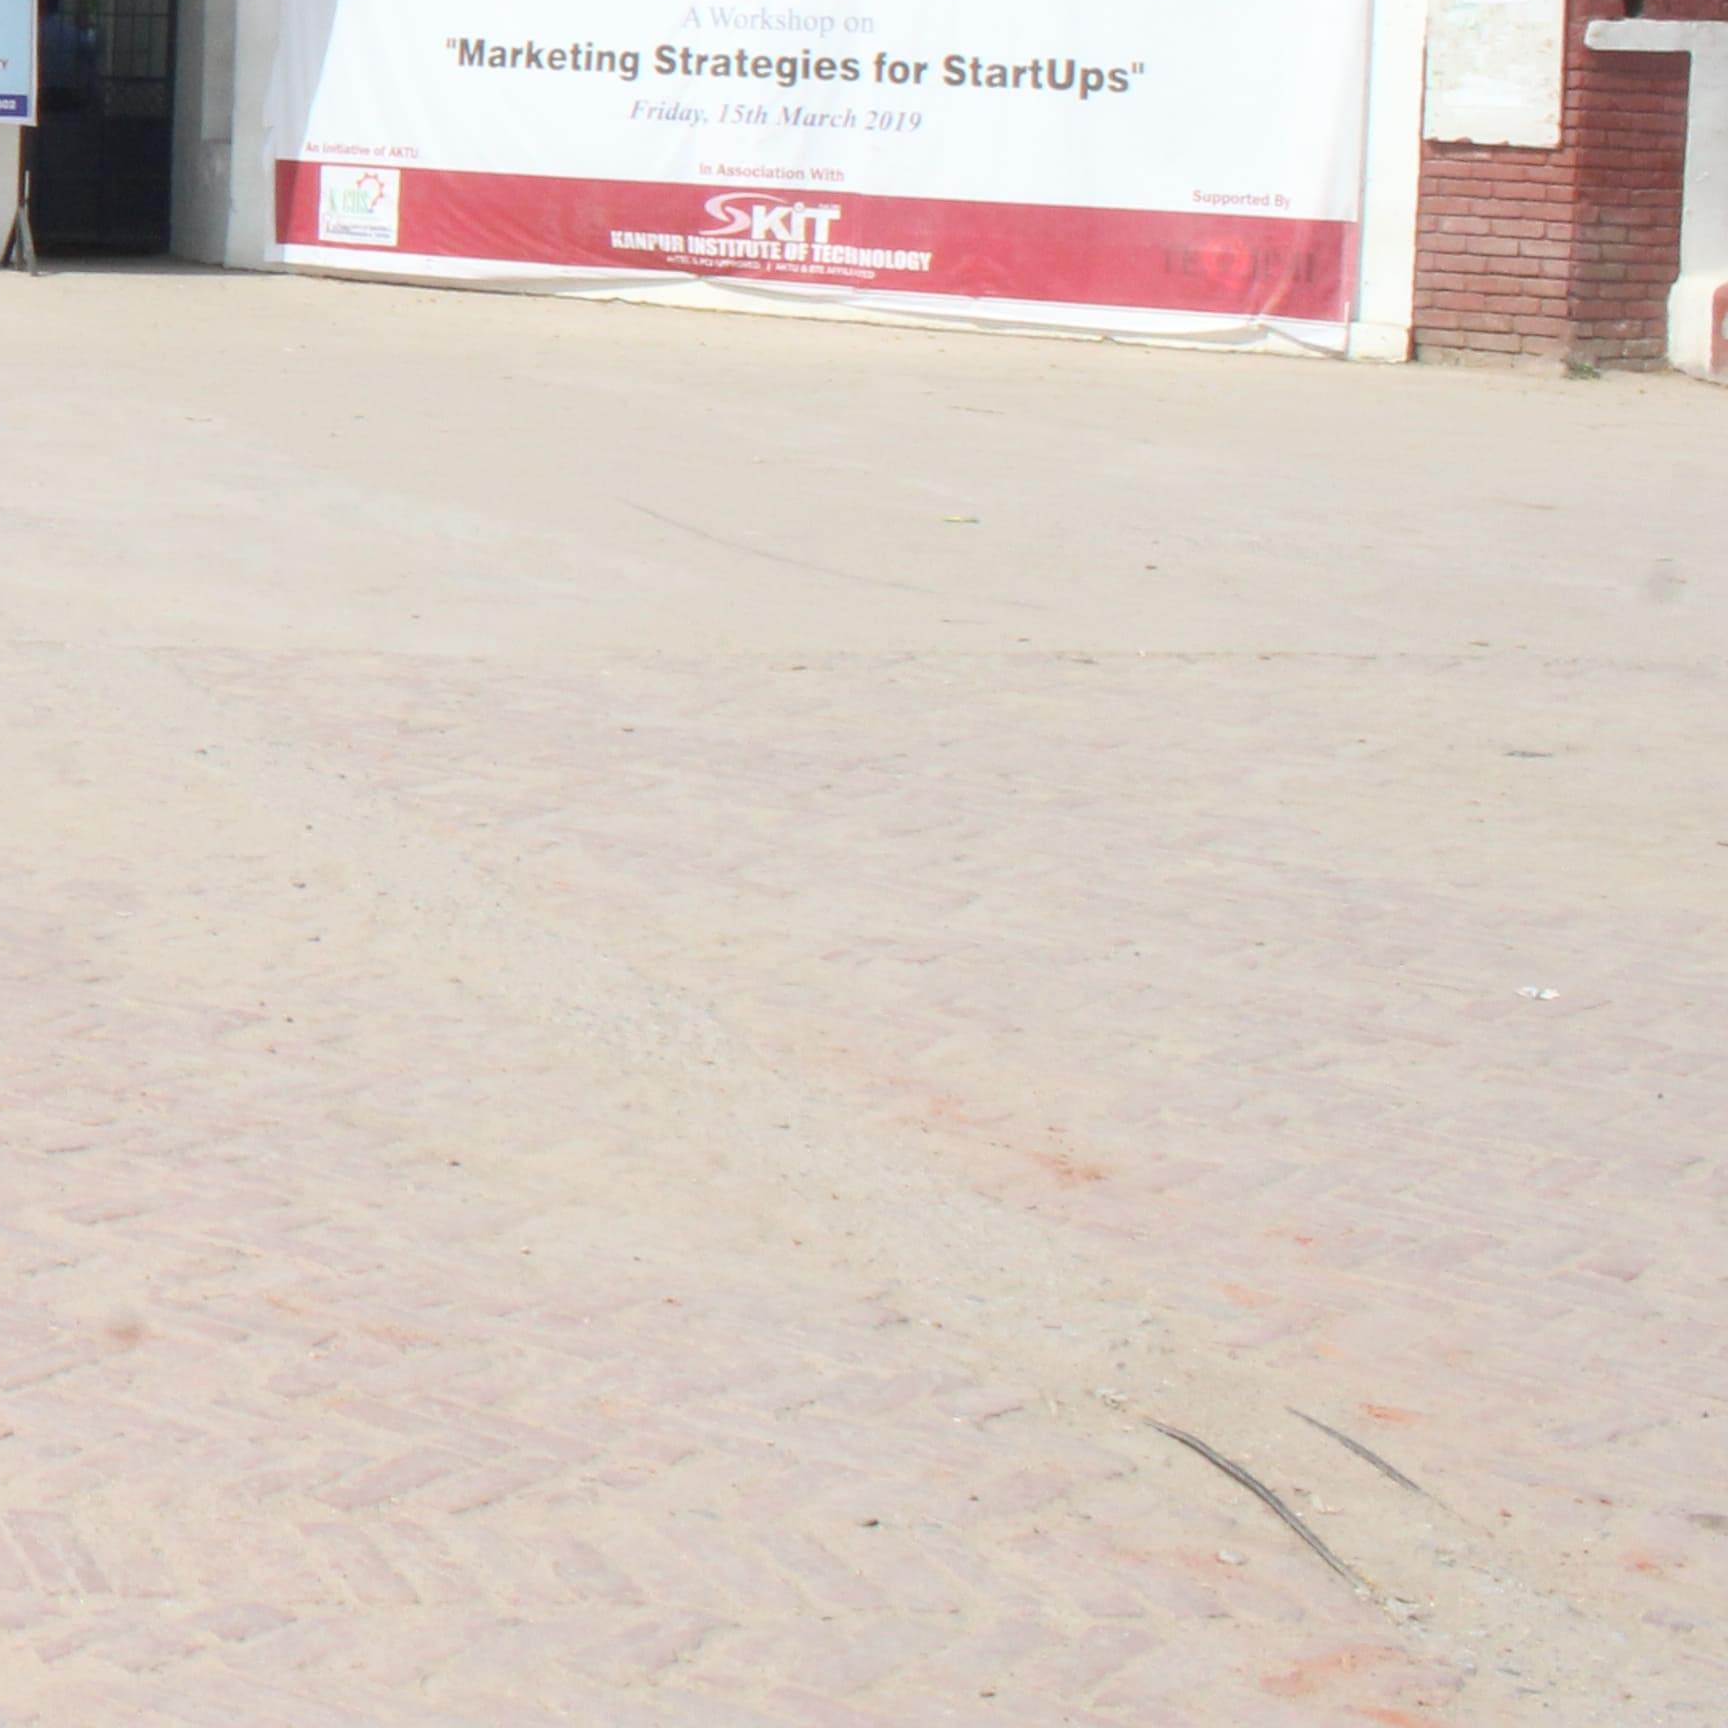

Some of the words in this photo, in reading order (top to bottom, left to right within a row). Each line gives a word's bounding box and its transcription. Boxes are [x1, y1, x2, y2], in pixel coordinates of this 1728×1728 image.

[680, 6, 703, 29] A
[711, 6, 835, 37] Workshop
[844, 15, 874, 33] on
[446, 37, 640, 82] "Marketing
[654, 44, 861, 88] Strategies
[874, 51, 928, 84] for
[943, 54, 1144, 100] StartUps"
[630, 99, 707, 127] Friday,
[718, 103, 767, 126] 15th
[775, 105, 857, 129] March
[865, 109, 922, 132] 2019
[323, 143, 370, 156] Initiative
[374, 145, 385, 156] of
[389, 146, 418, 158] AKTU
[716, 164, 804, 180] Association
[810, 167, 844, 181] With
[1192, 189, 1270, 207] Supported
[1274, 194, 1291, 209] By
[610, 230, 684, 253] KANPUR
[688, 236, 781, 260] INSTITUTE
[784, 242, 809, 262] OF
[812, 243, 932, 271] TECHNOLOGY
